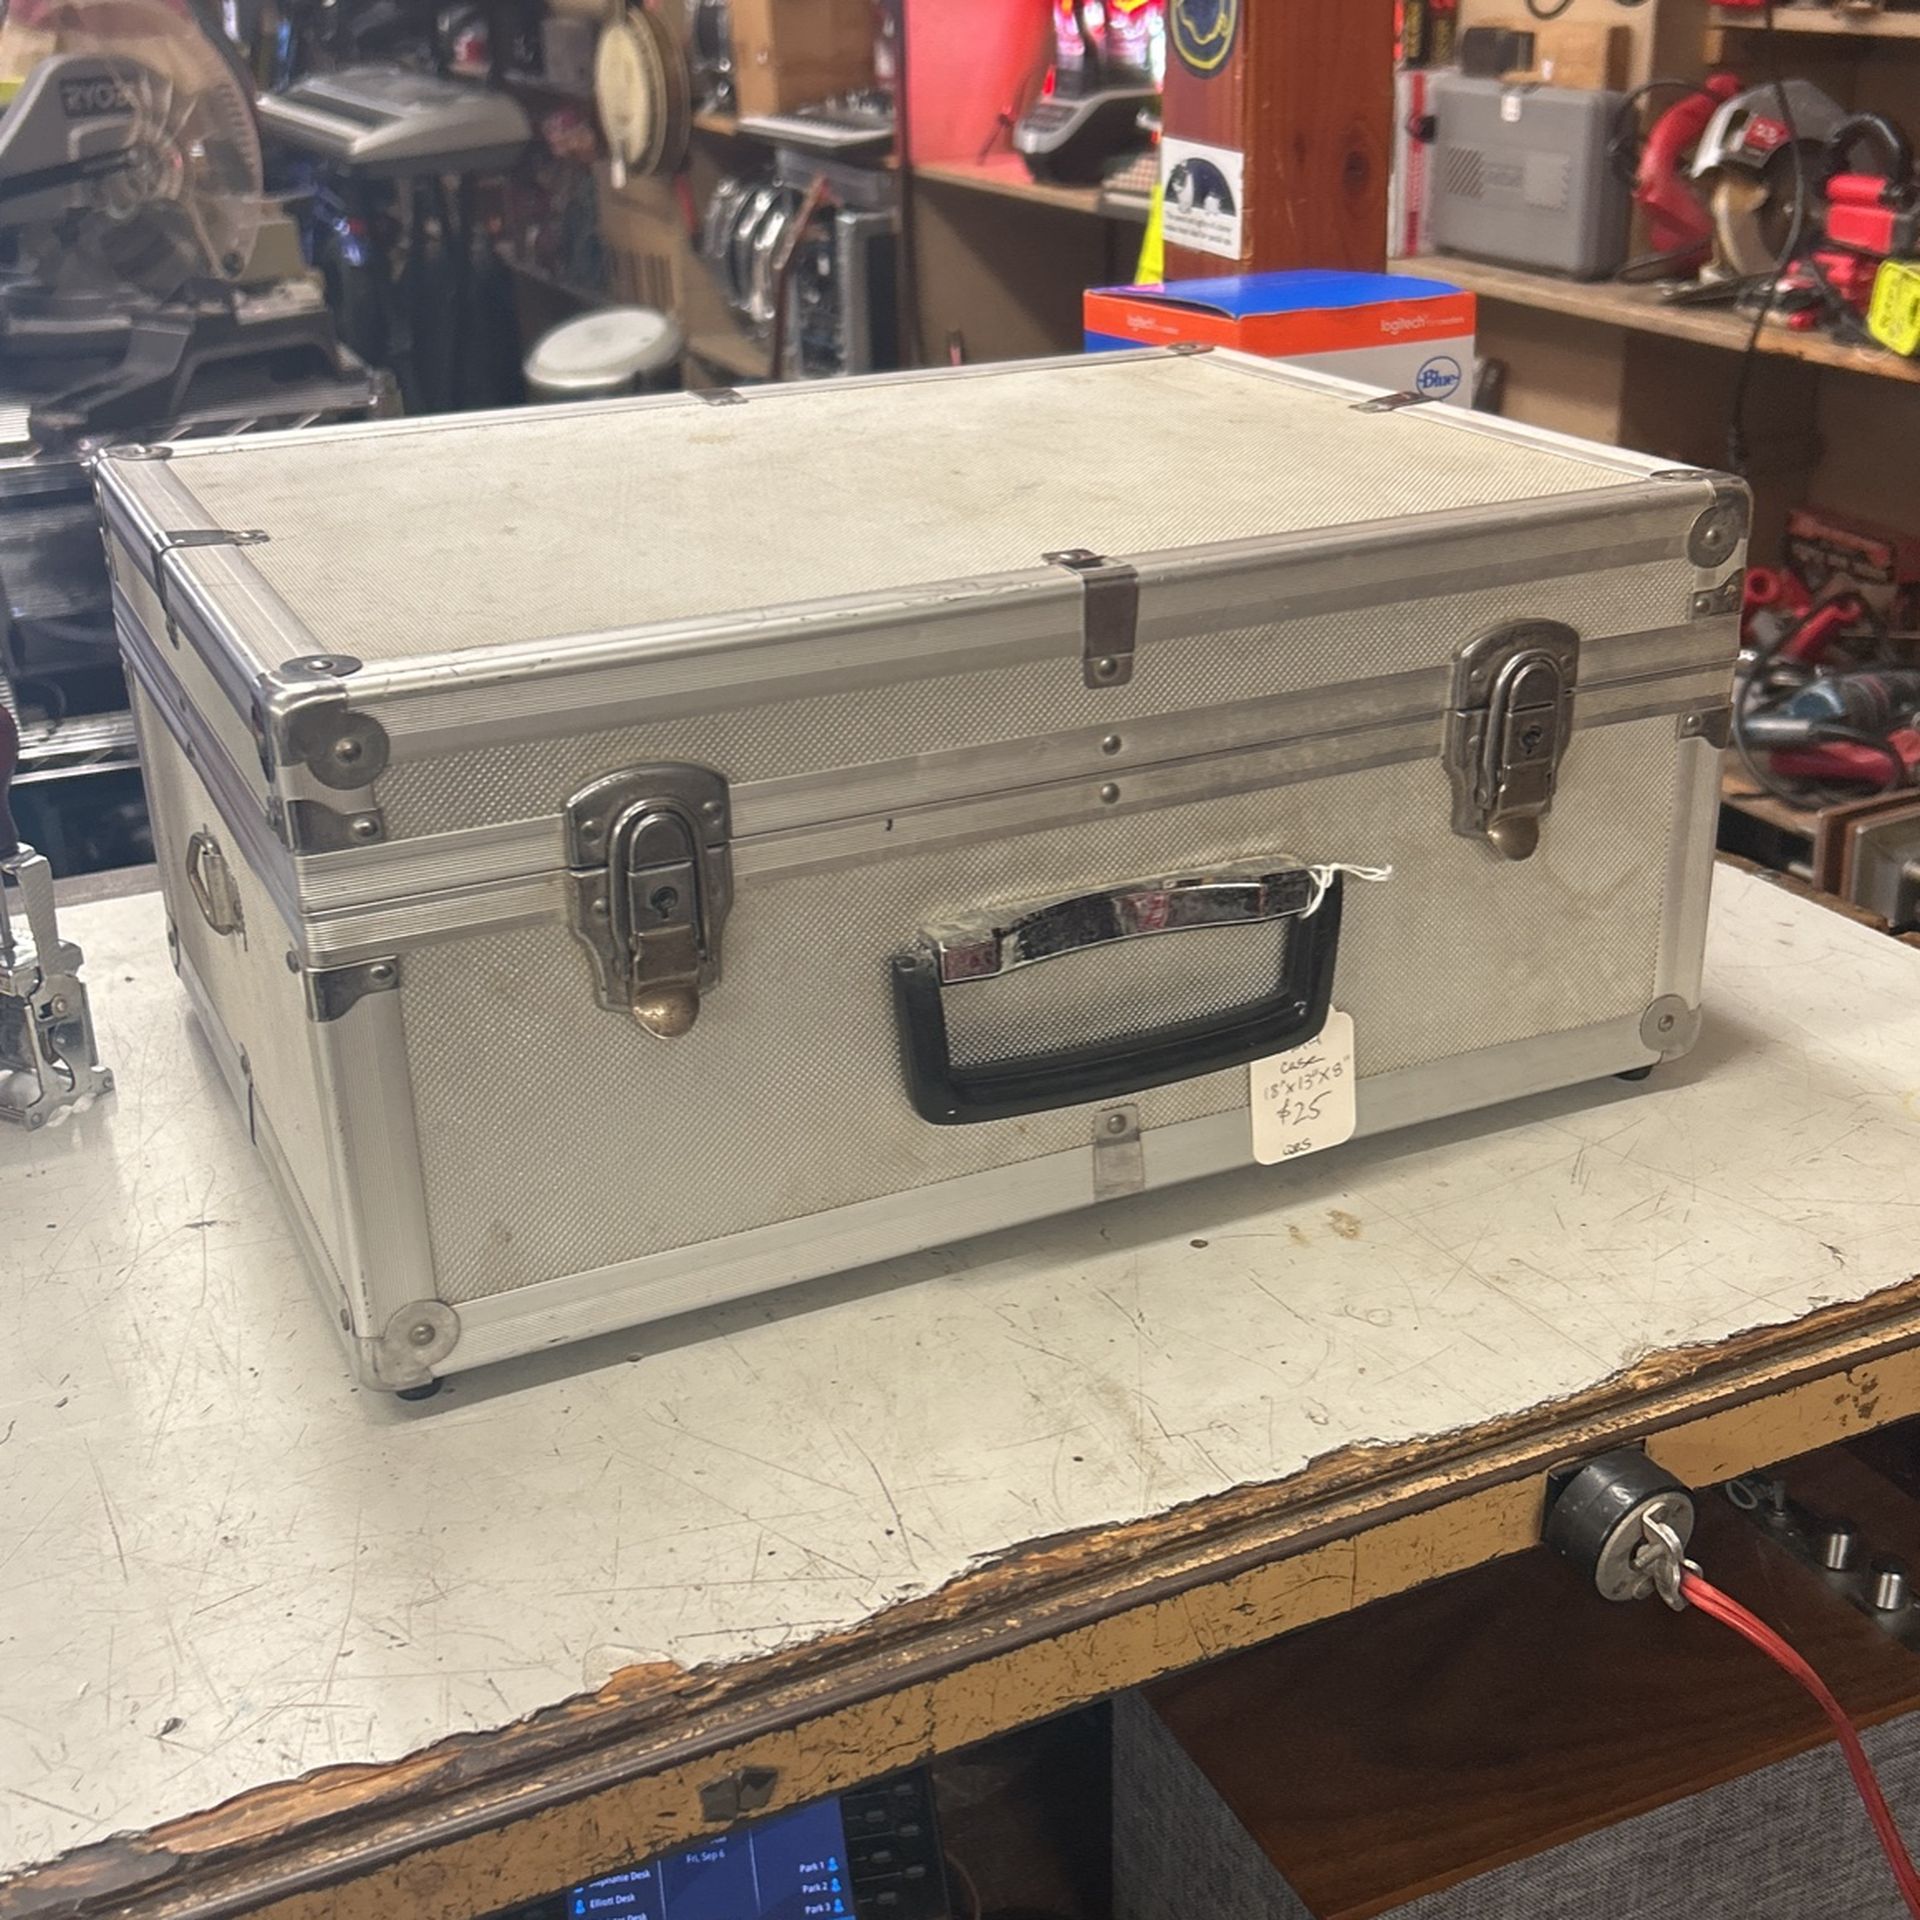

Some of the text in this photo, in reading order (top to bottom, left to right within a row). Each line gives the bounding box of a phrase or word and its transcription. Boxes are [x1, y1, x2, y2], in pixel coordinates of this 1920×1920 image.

[1380, 315, 1425, 335] logitech
[1419, 369, 1458, 389] Blue
[1276, 1090, 1332, 1125] $25
[702, 1851, 718, 1862] Sep
[718, 1848, 725, 1858] 6
[799, 1862, 818, 1873] Park
[630, 1869, 651, 1880] Desk
[802, 1881, 828, 1893] Park 2
[615, 1893, 635, 1905] Desk
[805, 1902, 831, 1914] Park 3
